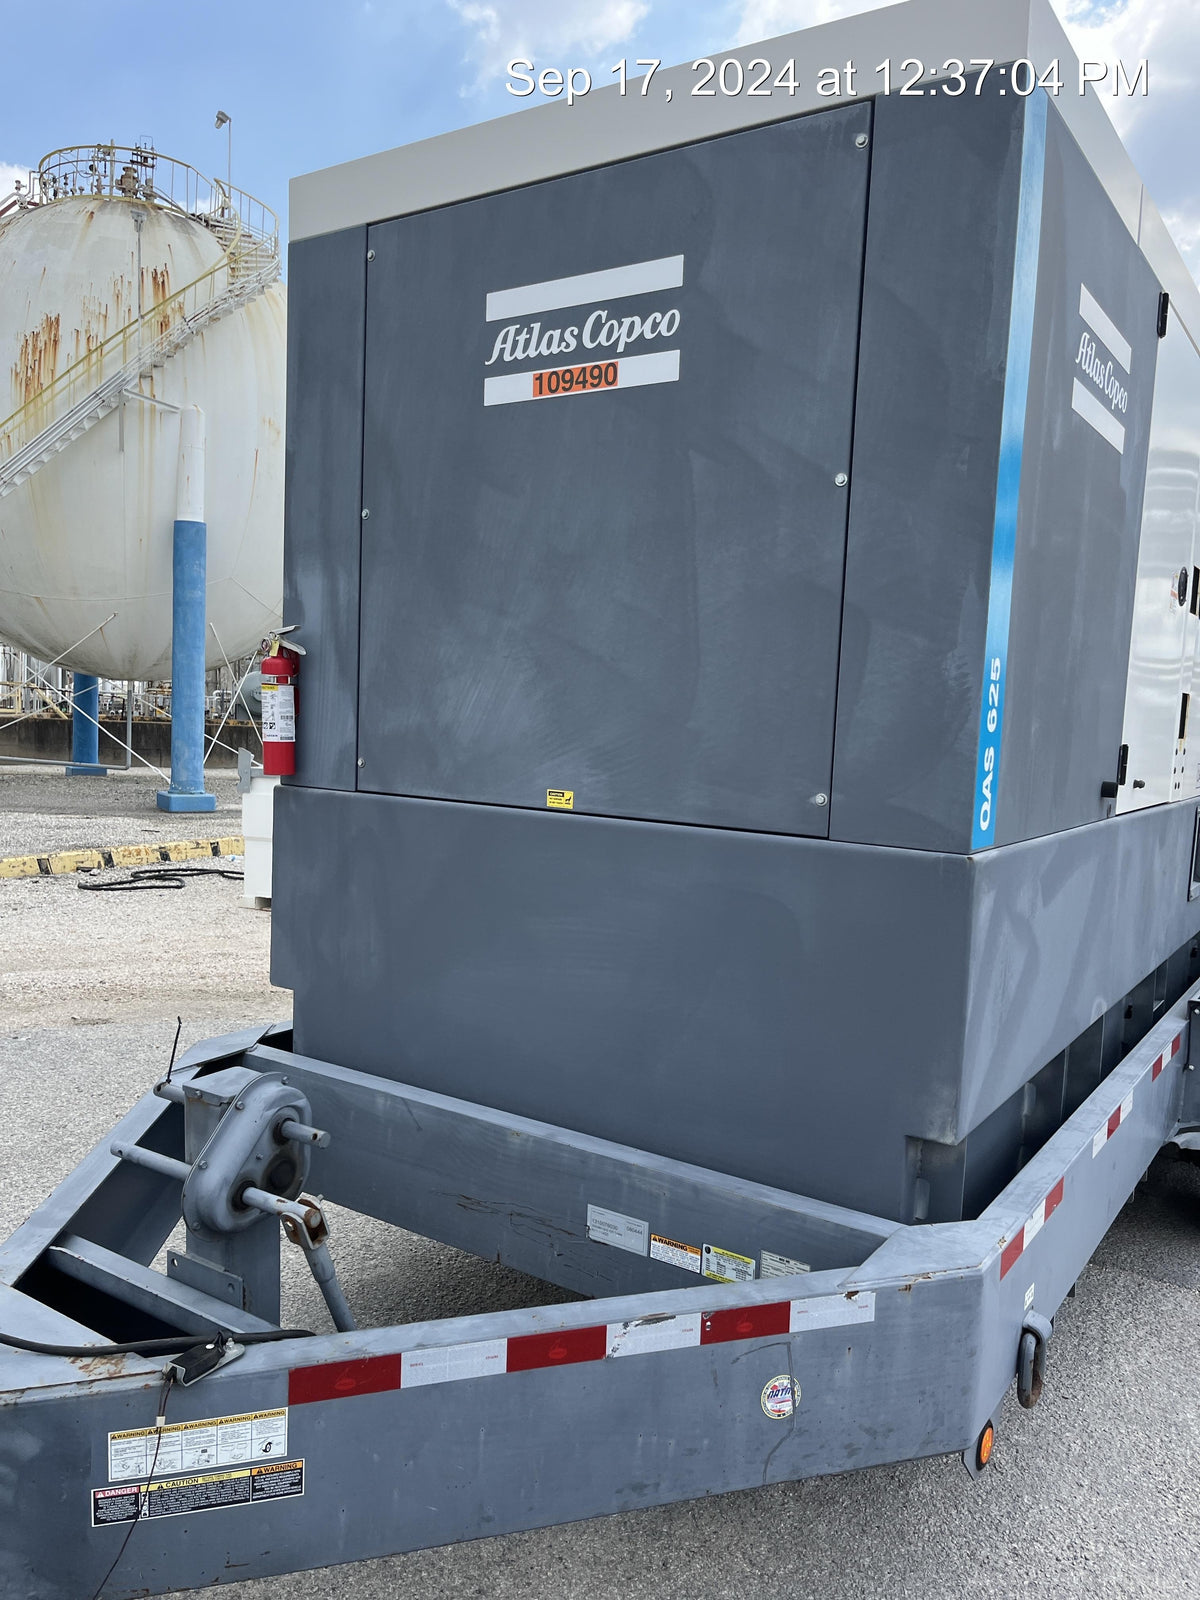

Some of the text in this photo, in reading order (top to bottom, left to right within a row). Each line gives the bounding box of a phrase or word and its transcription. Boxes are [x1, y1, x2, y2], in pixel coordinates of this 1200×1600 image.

[485, 309, 681, 365] Atlas Copco
[535, 361, 618, 395] 109490
[1075, 332, 1128, 414] Atlas Copco
[979, 657, 1001, 831] QAS 625
[658, 1237, 688, 1251] WARNING
[258, 1410, 285, 1418] WARNING
[188, 1420, 217, 1429] WARNING
[223, 1415, 251, 1424] WARNING
[117, 1431, 145, 1439] WARNING
[264, 1462, 298, 1473] WARNING
[165, 1478, 199, 1488] CAUTION
[105, 1487, 138, 1497] DANGER
